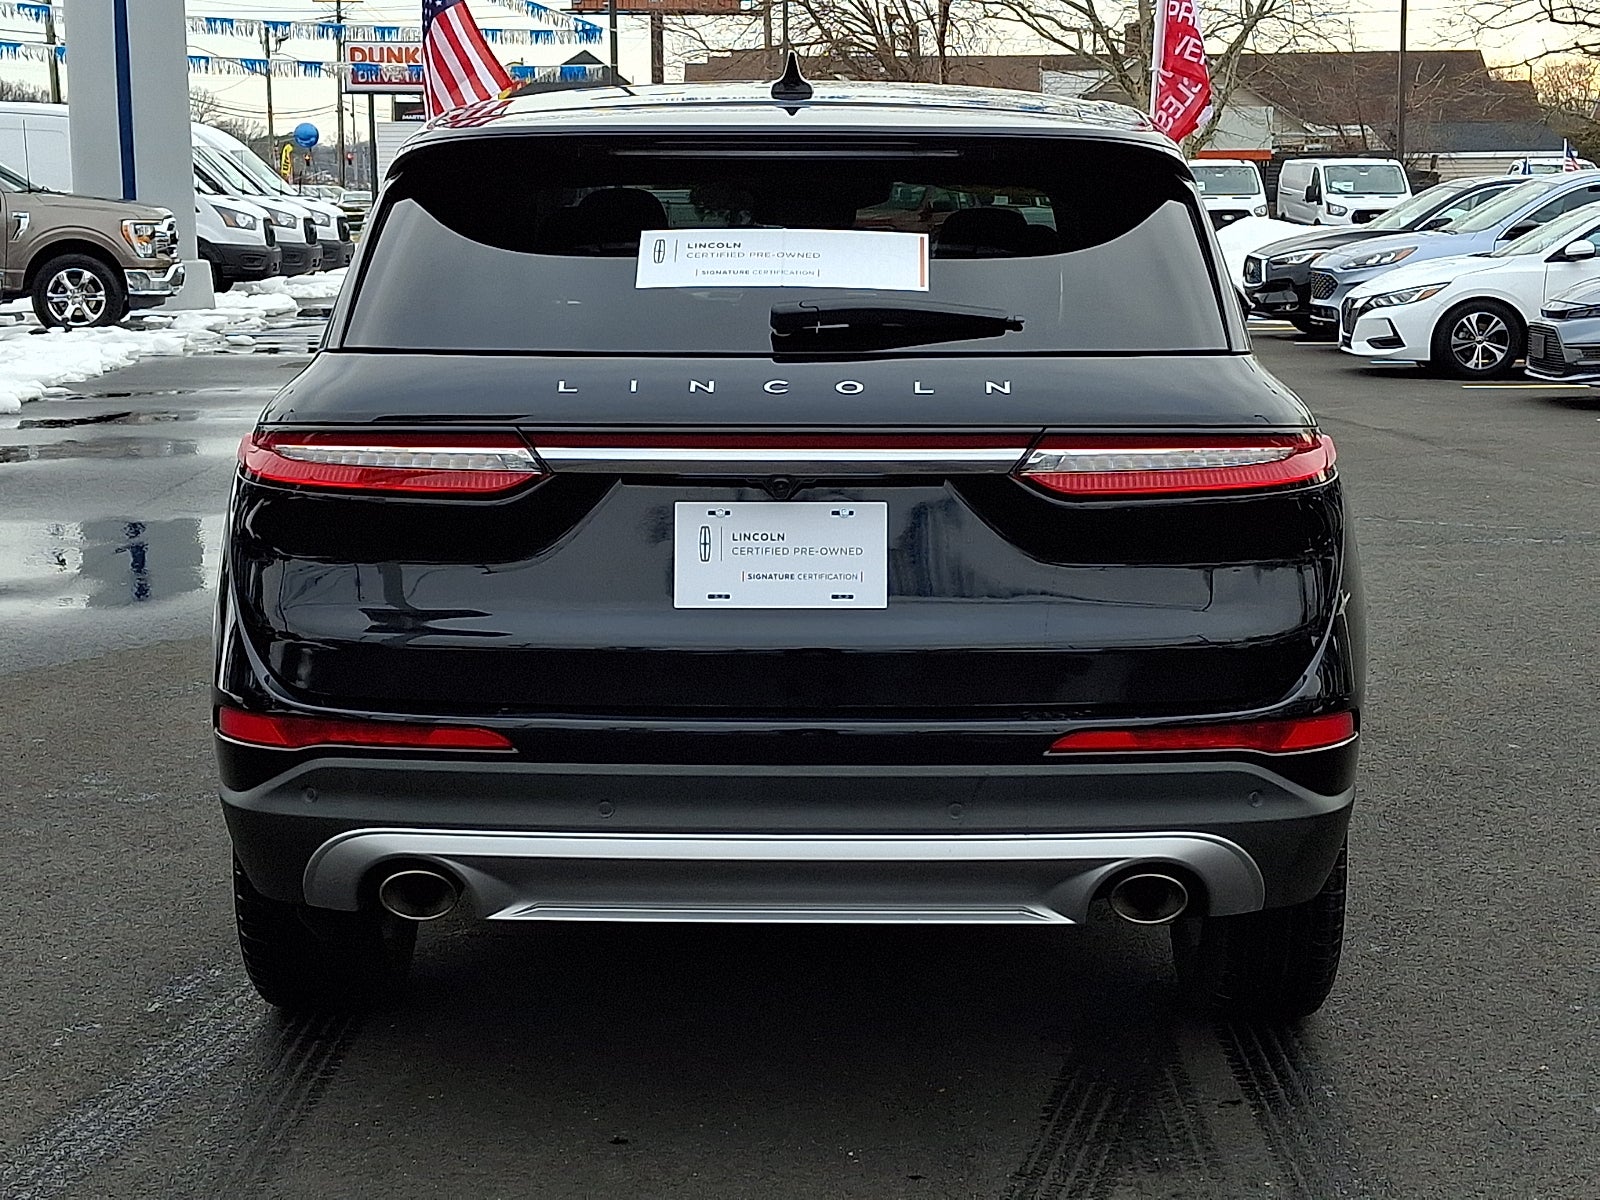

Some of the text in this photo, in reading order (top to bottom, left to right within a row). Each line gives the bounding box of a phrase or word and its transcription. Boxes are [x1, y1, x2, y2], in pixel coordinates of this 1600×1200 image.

[686, 251, 821, 259] CERTIFIED PRE-OWNED
[557, 379, 1012, 396] LINCOLN
[732, 532, 785, 542] LINCOLN
[732, 547, 863, 556] CERTIFIED PRE-OWNED
[747, 573, 858, 581] SIGNATURE CERTIFICATION
